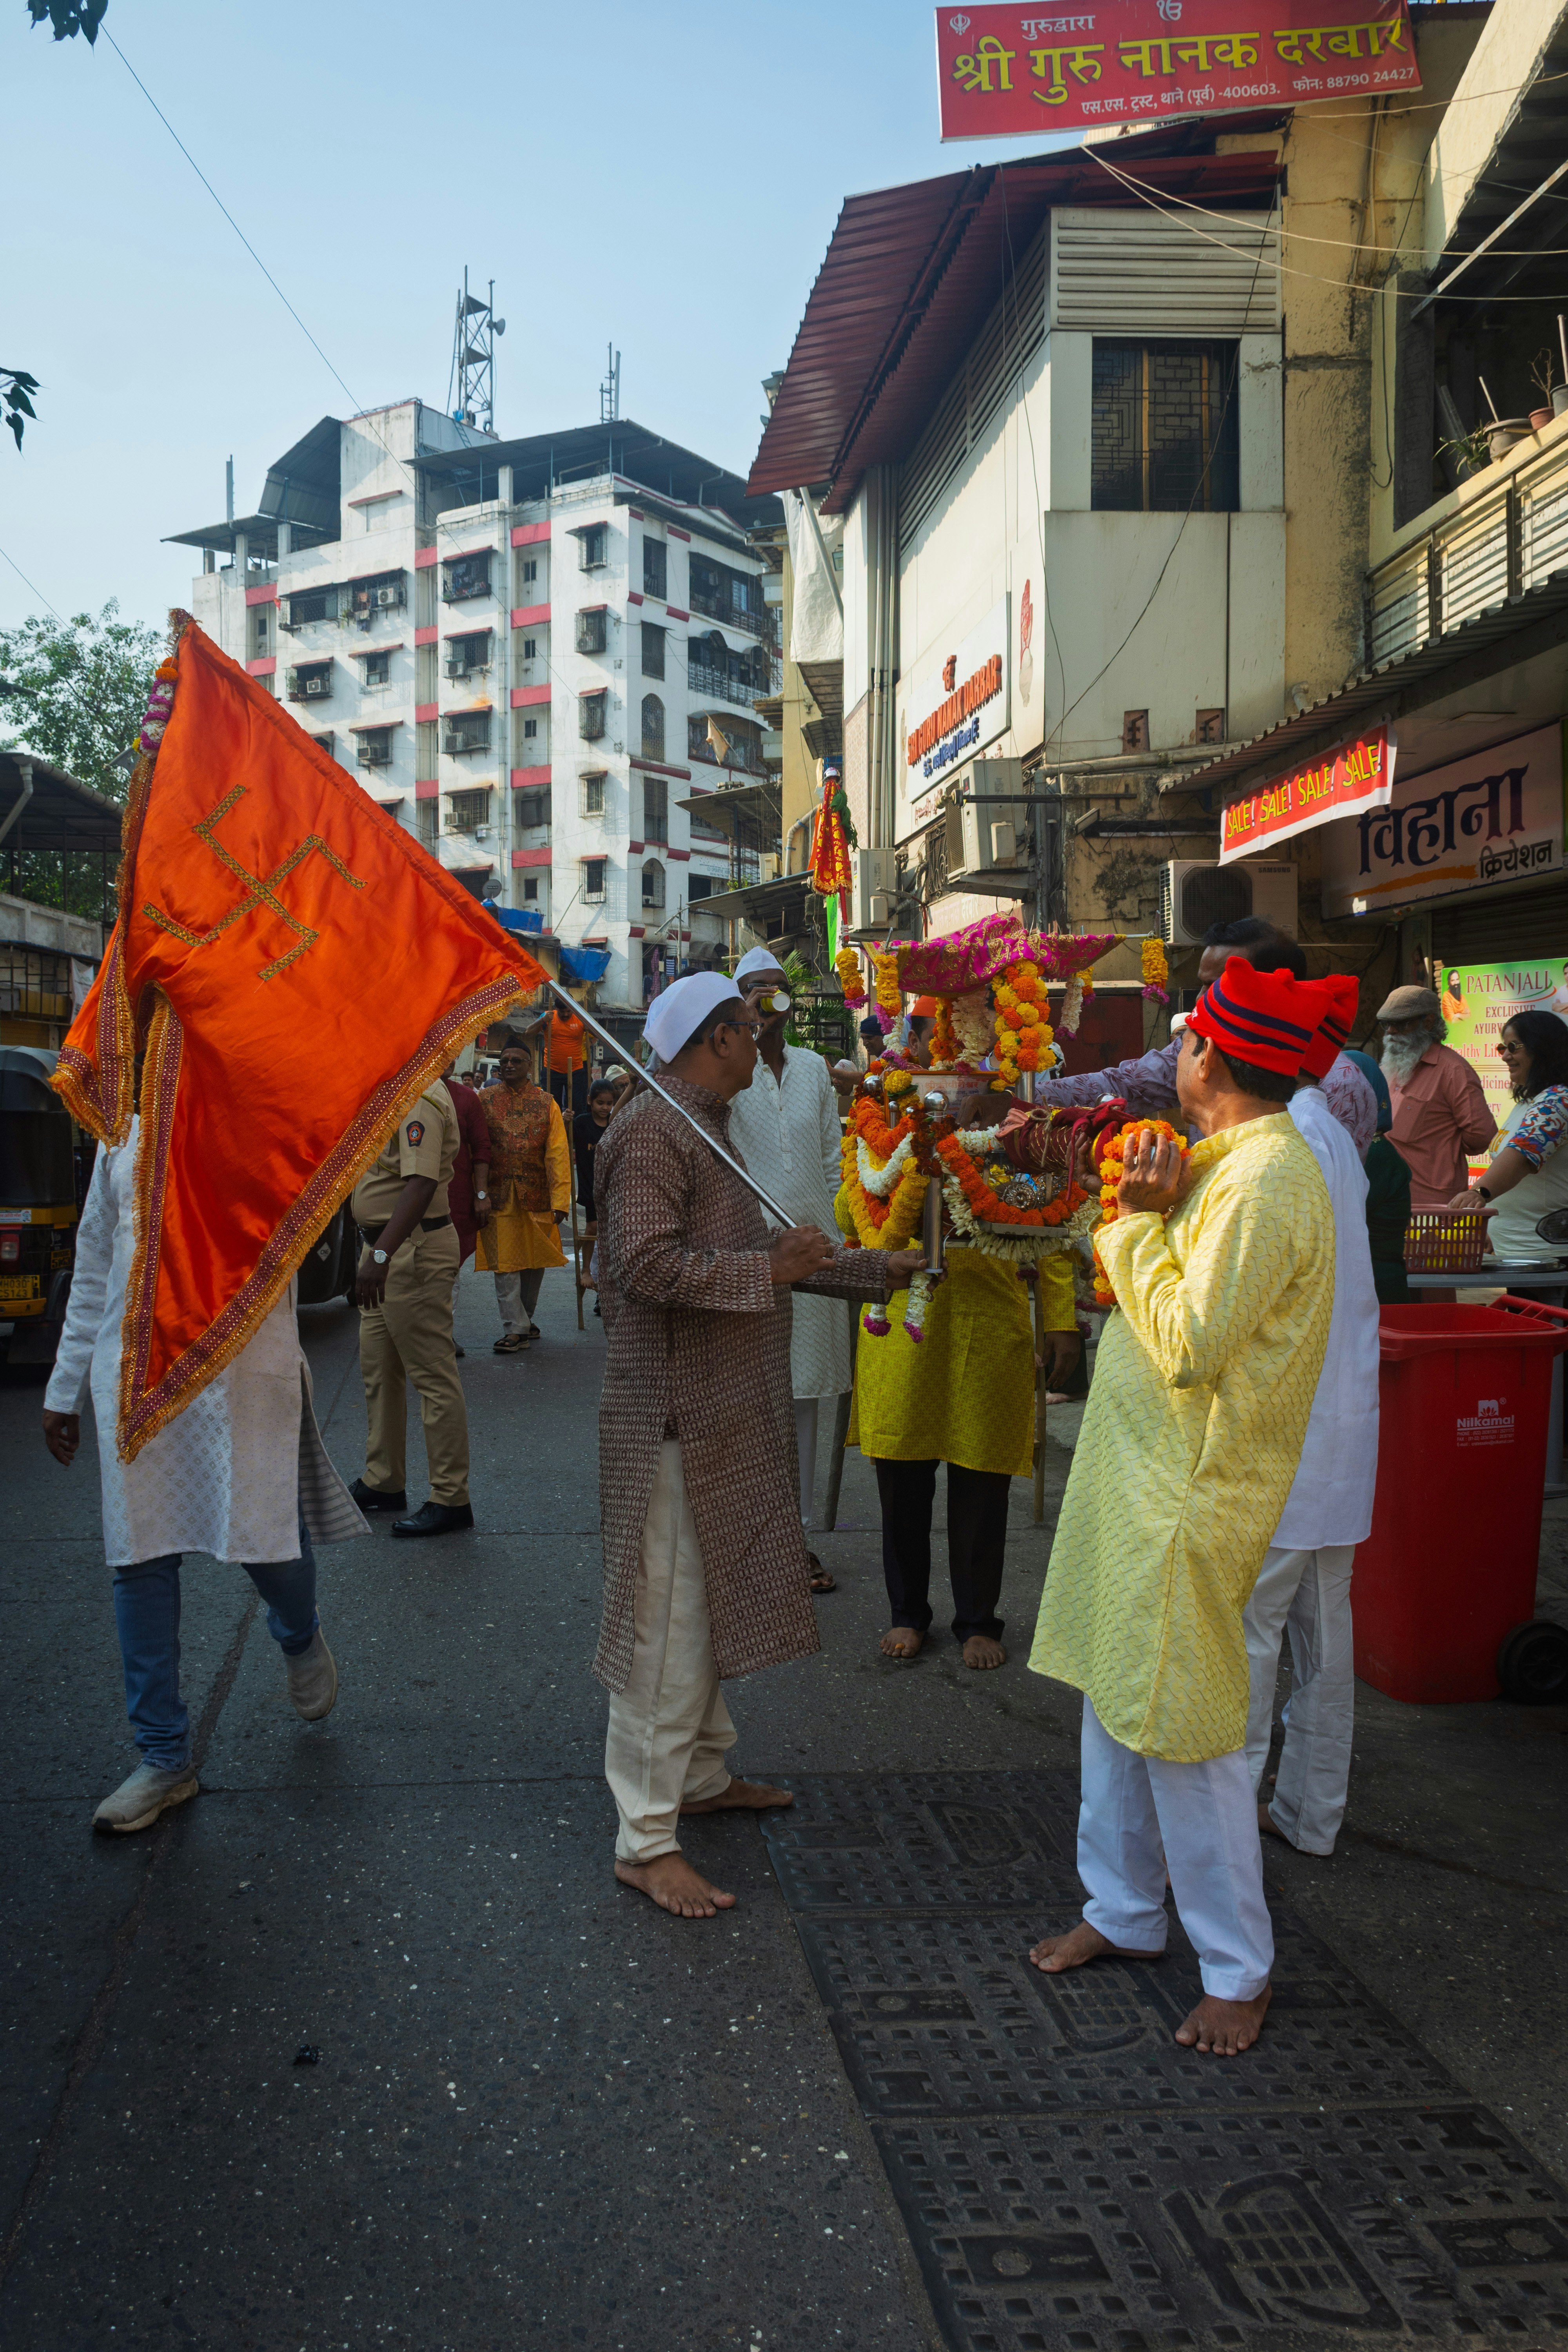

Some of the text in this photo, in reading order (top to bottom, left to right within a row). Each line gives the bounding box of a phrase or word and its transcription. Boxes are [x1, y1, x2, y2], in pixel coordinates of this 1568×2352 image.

[1021, 15, 1096, 40] गुरुद्वारा
[952, 18, 1408, 105] श्री गुरु नानक दरबार
[1082, 99, 1127, 114] एस.एस.
[1161, 87, 1184, 103] थाने
[1187, 84, 1215, 105] (पूर्व)
[1292, 76, 1323, 92] फोन:
[1327, 73, 1369, 89] 88790
[1373, 67, 1414, 83] 24427
[907, 654, 1002, 766] SRI GURU NANAK DARBAR
[1227, 742, 1383, 838] SALE! SALE! SALE! SALE!
[1466, 970, 1550, 995] PATANJALI
[1474, 1022, 1506, 1034] AYURV
[1445, 1043, 1481, 1063] althy
[1457, 1415, 1515, 1428] Nilkamal
